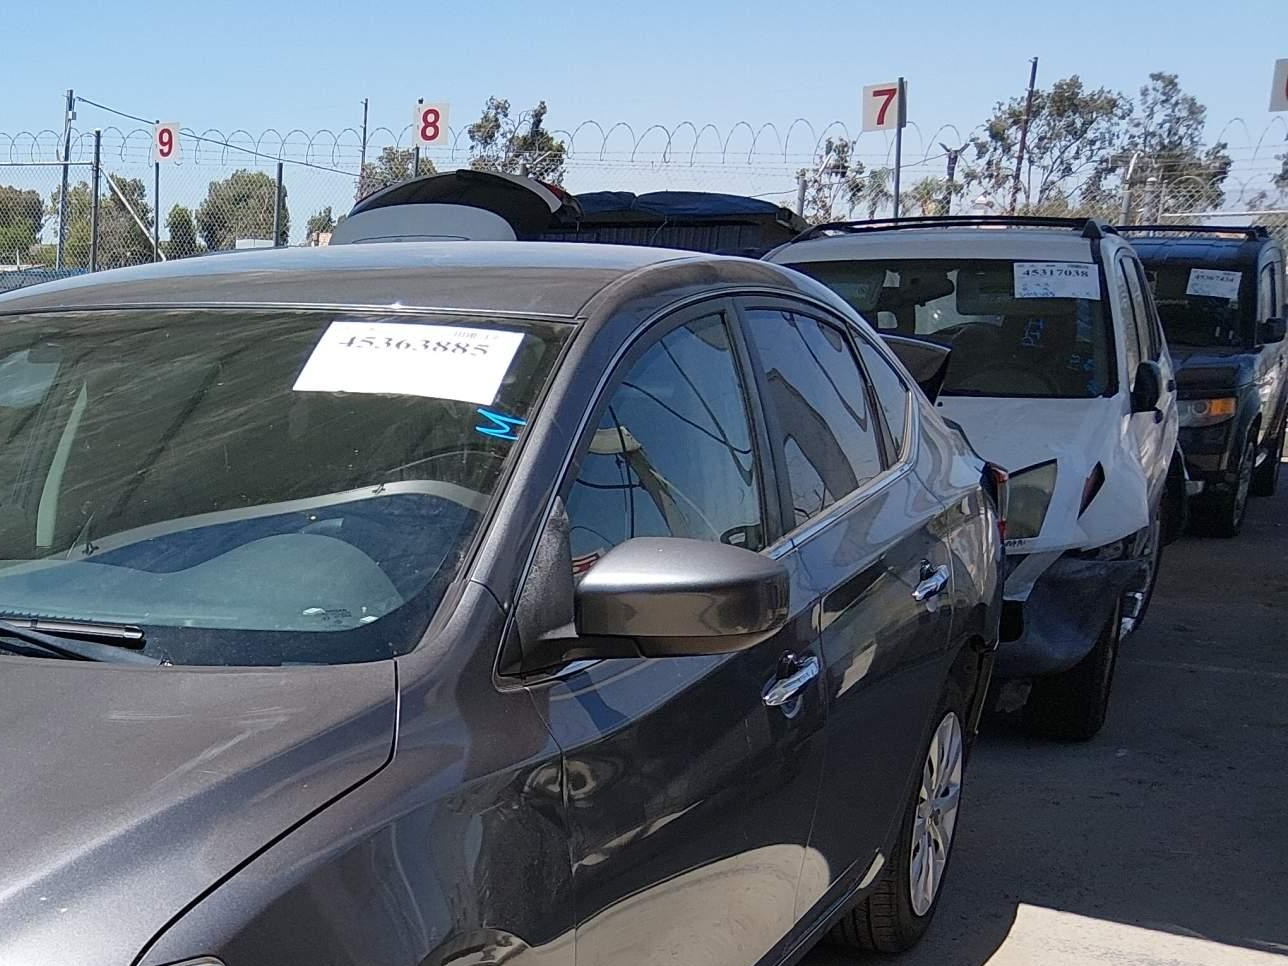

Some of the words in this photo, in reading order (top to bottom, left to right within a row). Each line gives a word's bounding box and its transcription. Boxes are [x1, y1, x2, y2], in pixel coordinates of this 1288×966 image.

[872, 87, 897, 126] 7
[420, 108, 440, 142] 8
[158, 127, 173, 158] 9
[337, 335, 490, 357] 45363885
